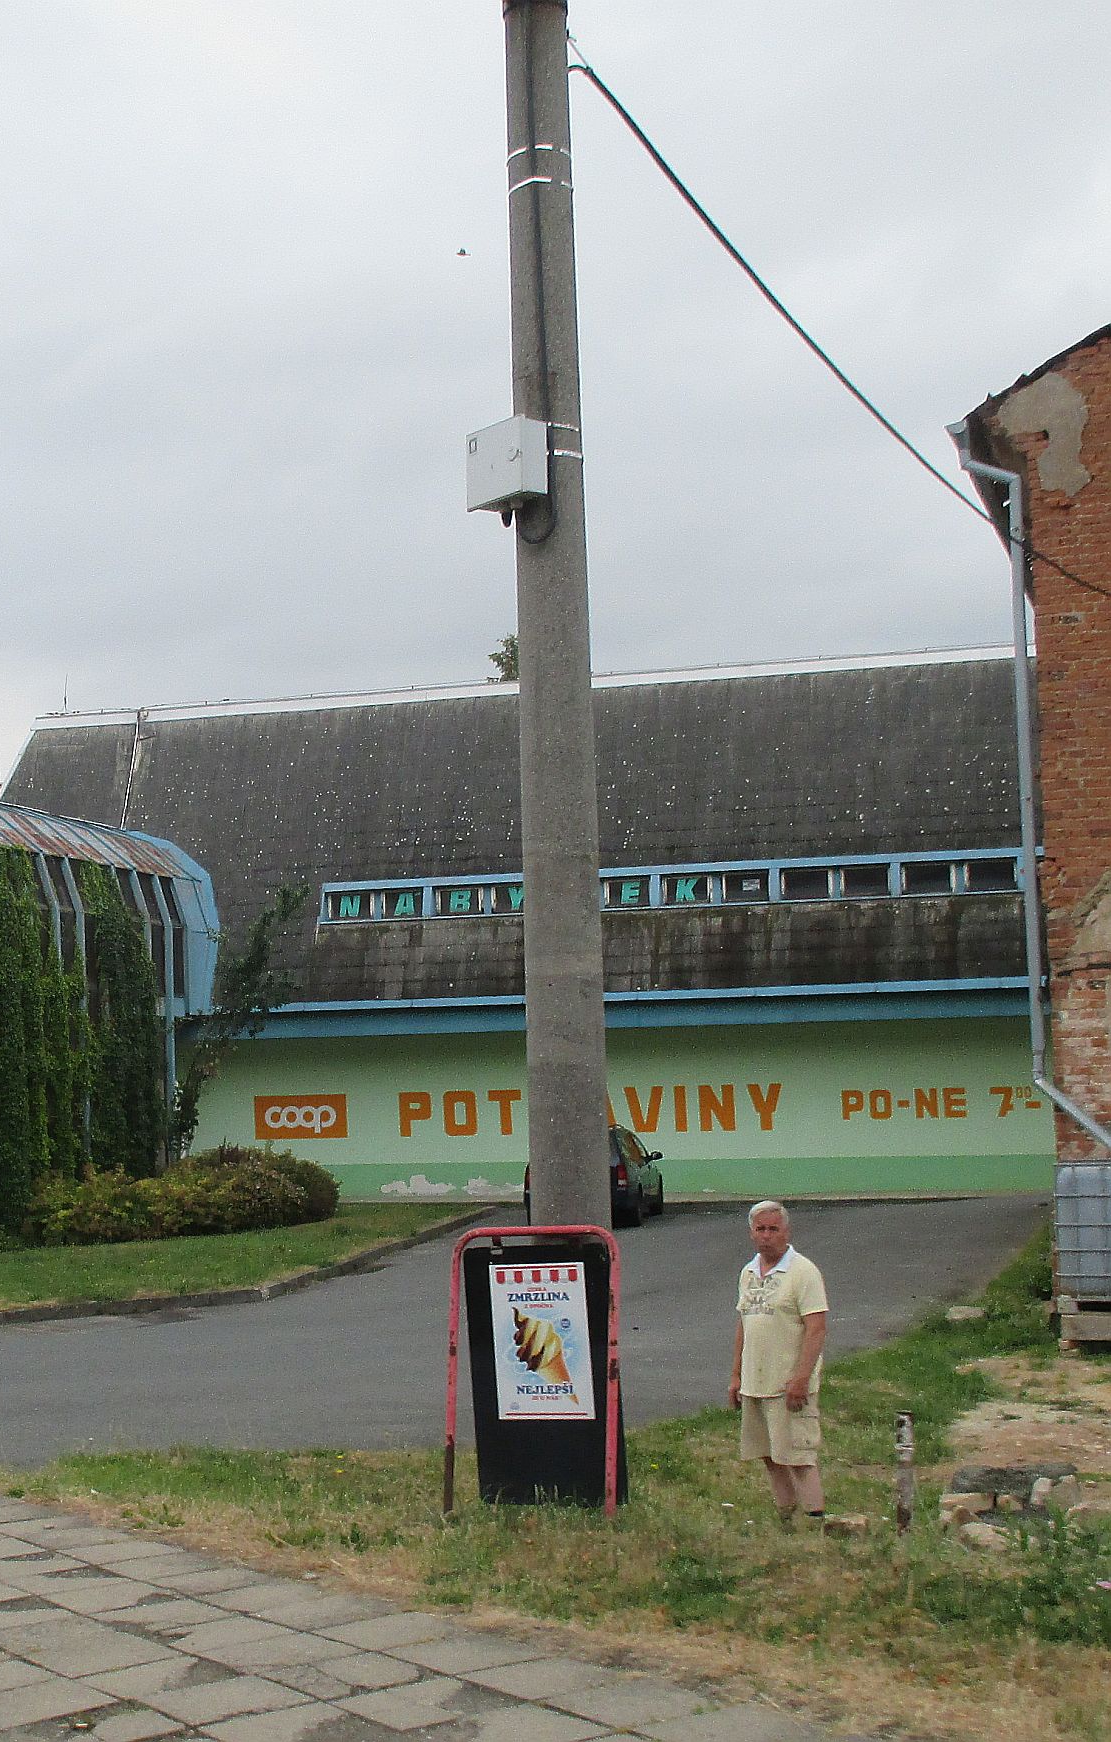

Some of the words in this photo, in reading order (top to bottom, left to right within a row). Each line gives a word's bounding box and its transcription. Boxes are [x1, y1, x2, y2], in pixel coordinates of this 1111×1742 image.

[265, 1105, 337, 1134] coop
[398, 1082, 783, 1137] POTVINY
[842, 1087, 968, 1120] PO-NE
[507, 1291, 570, 1303] ZMRZLINA
[516, 1382, 574, 1395] NEJLEPŠÍ
